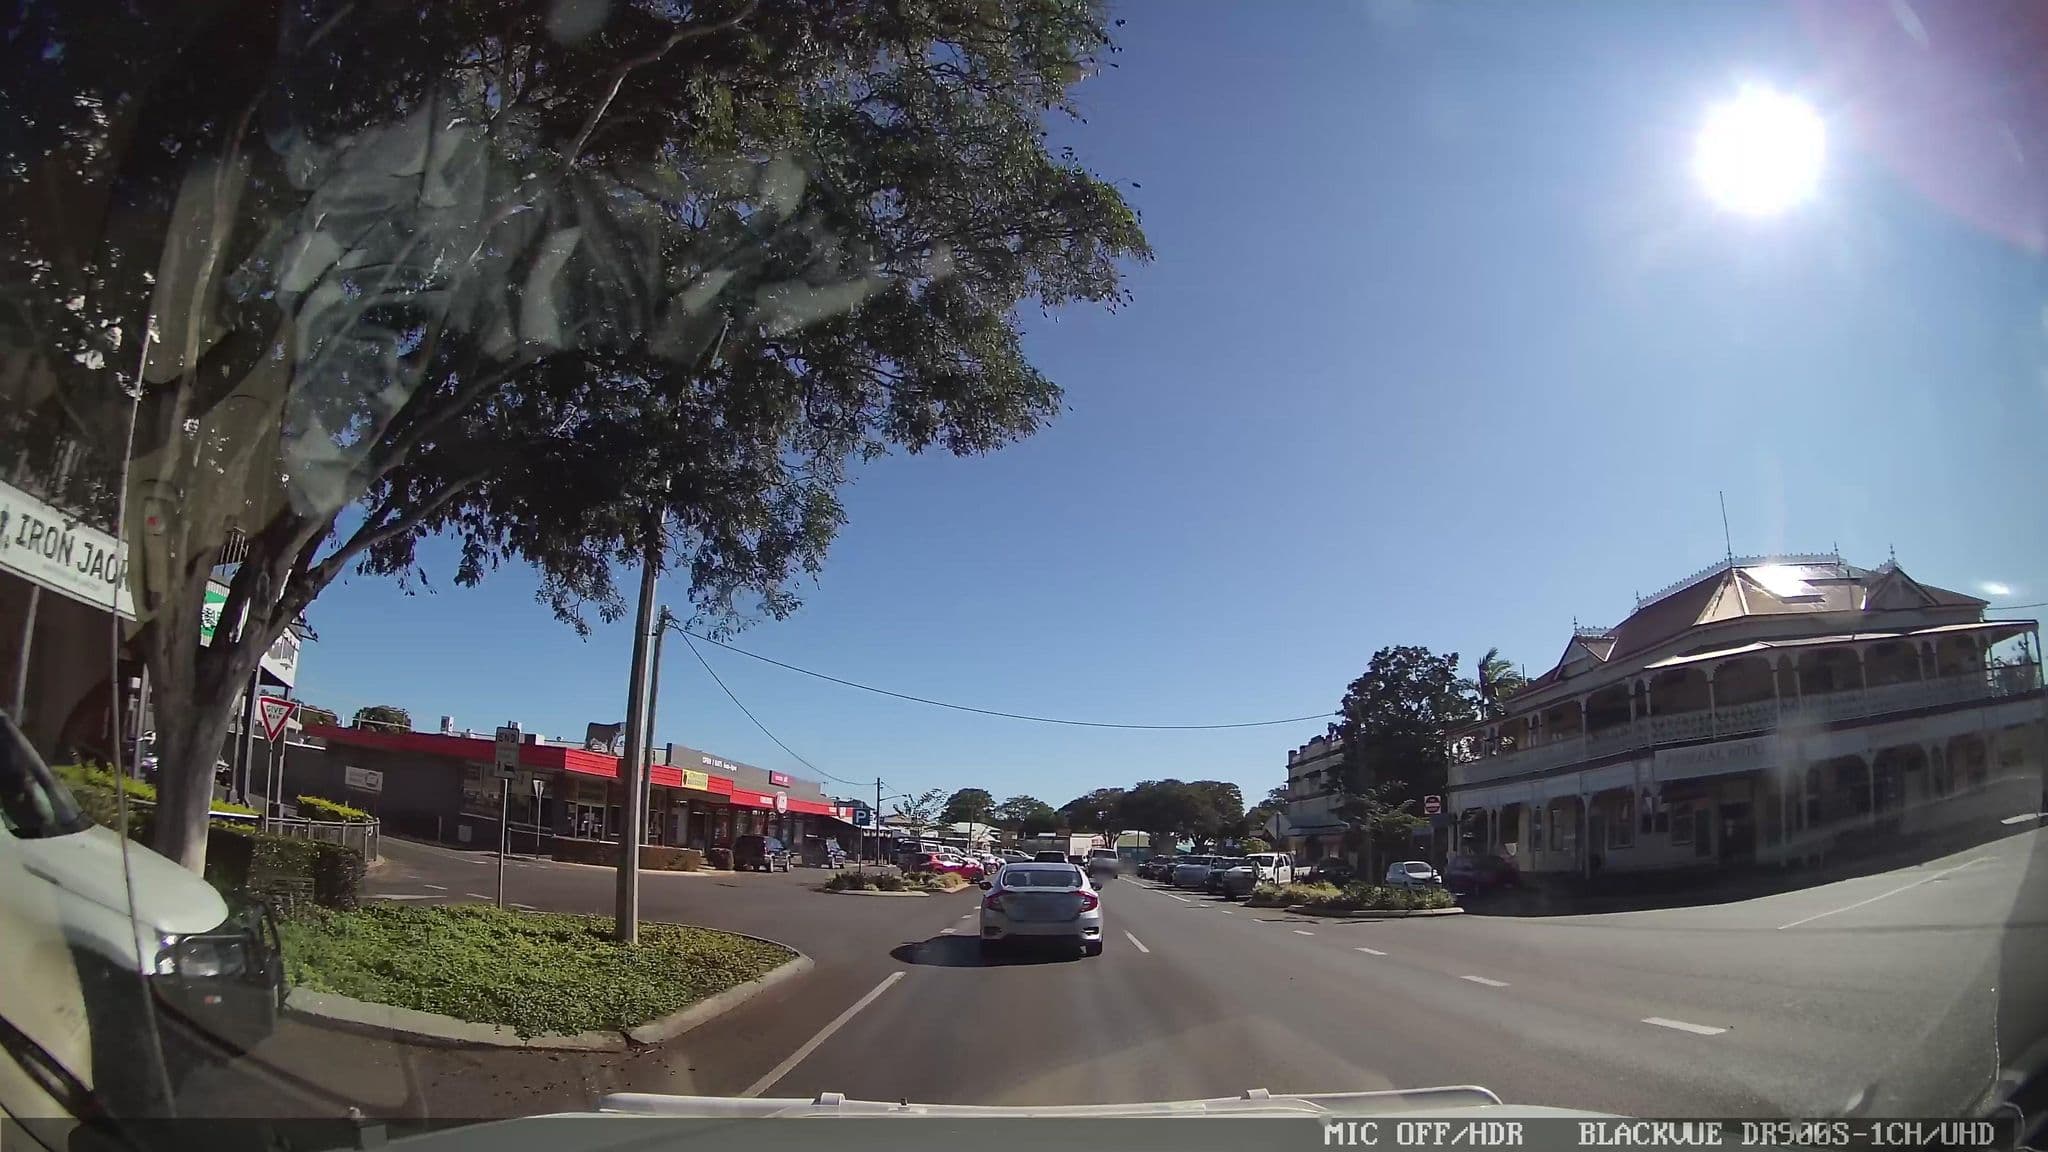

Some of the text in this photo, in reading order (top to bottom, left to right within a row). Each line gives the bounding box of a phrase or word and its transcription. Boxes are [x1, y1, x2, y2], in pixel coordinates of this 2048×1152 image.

[16, 513, 75, 567] IRON
[266, 705, 284, 715] GIVE
[856, 810, 867, 823] P
